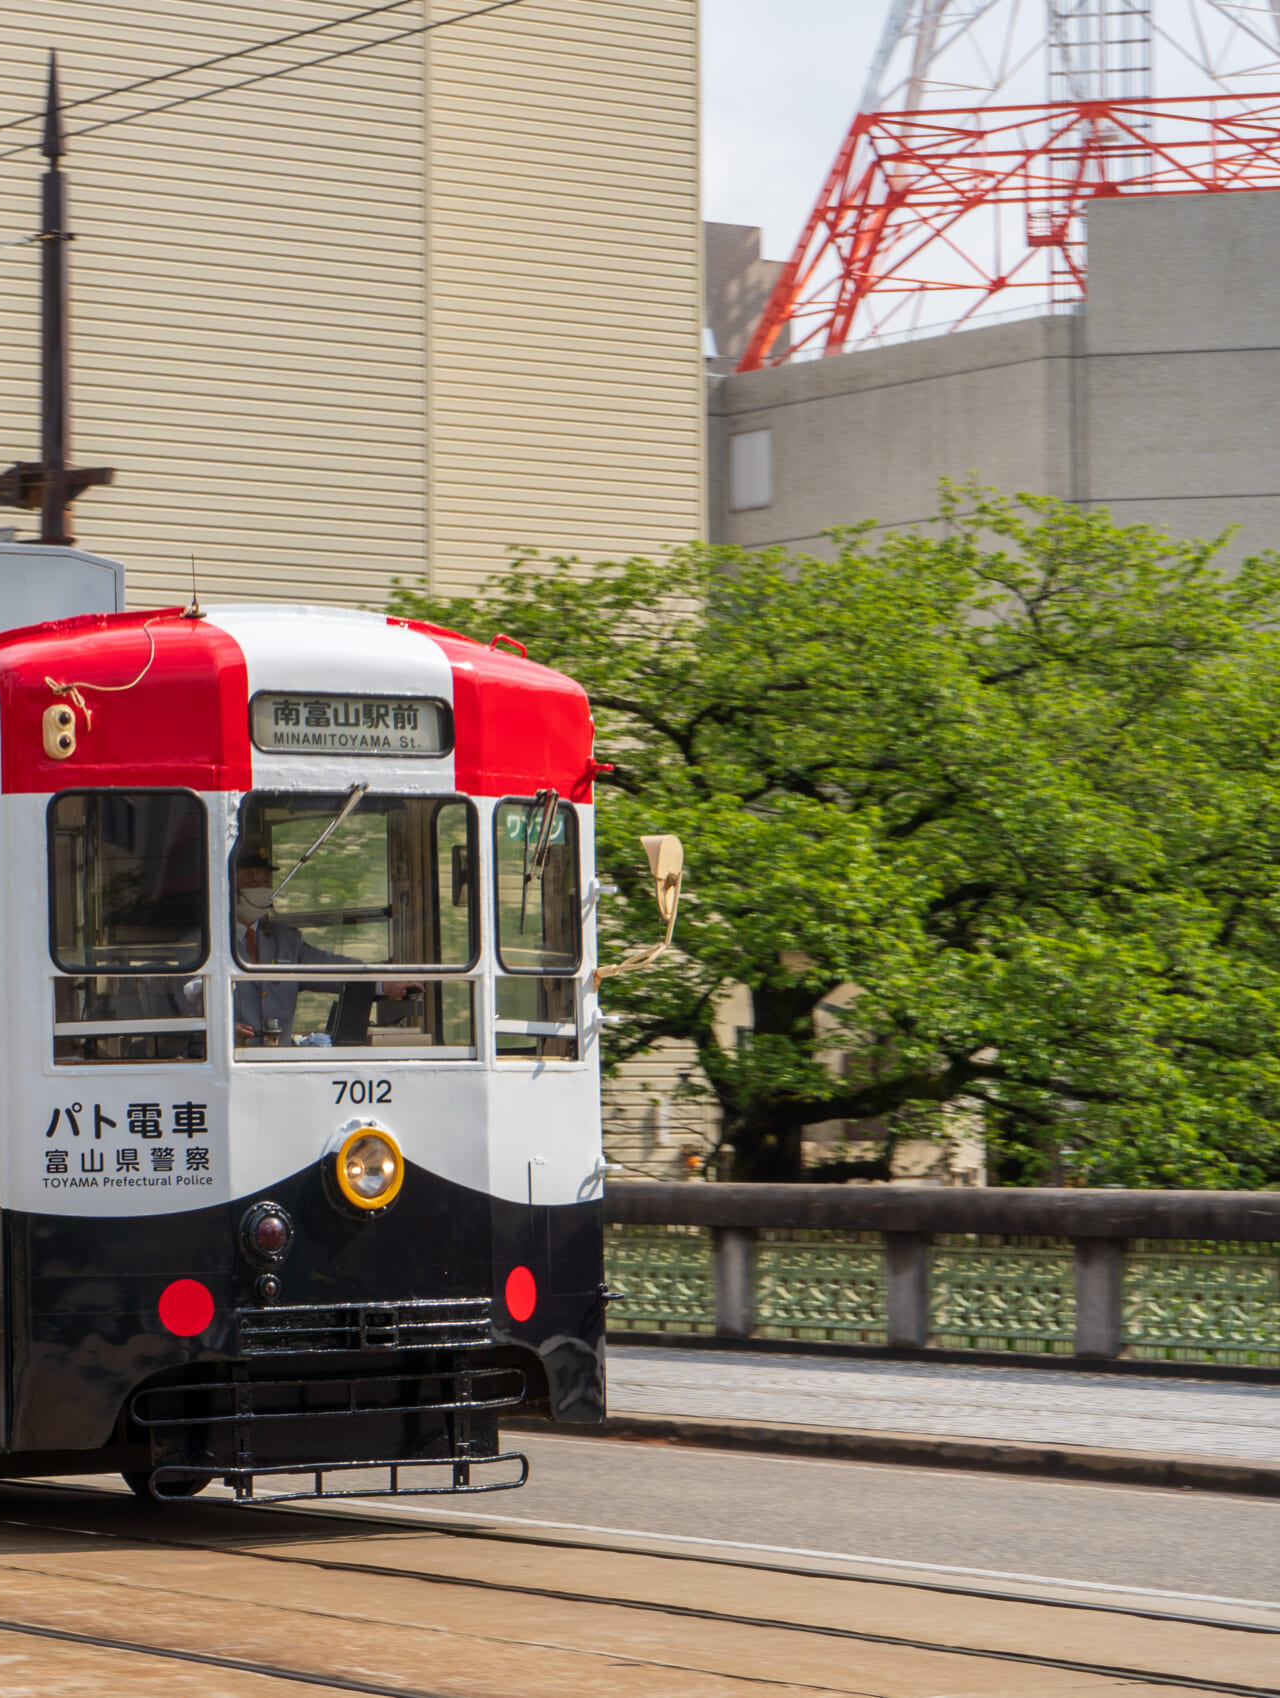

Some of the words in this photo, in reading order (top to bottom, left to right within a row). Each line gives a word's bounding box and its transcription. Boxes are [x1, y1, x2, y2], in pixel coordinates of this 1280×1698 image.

[272, 700, 419, 730] 南富山駅前
[273, 732, 391, 748] MINAMITOYAMA
[399, 736, 421, 749] St.
[331, 1079, 393, 1104] 7012
[46, 1101, 208, 1139] パト電車
[45, 1147, 210, 1174] 富山県警察
[42, 1177, 99, 1189] TOYAMA
[103, 1176, 172, 1187] Prefectural
[176, 1175, 213, 1186] Police
